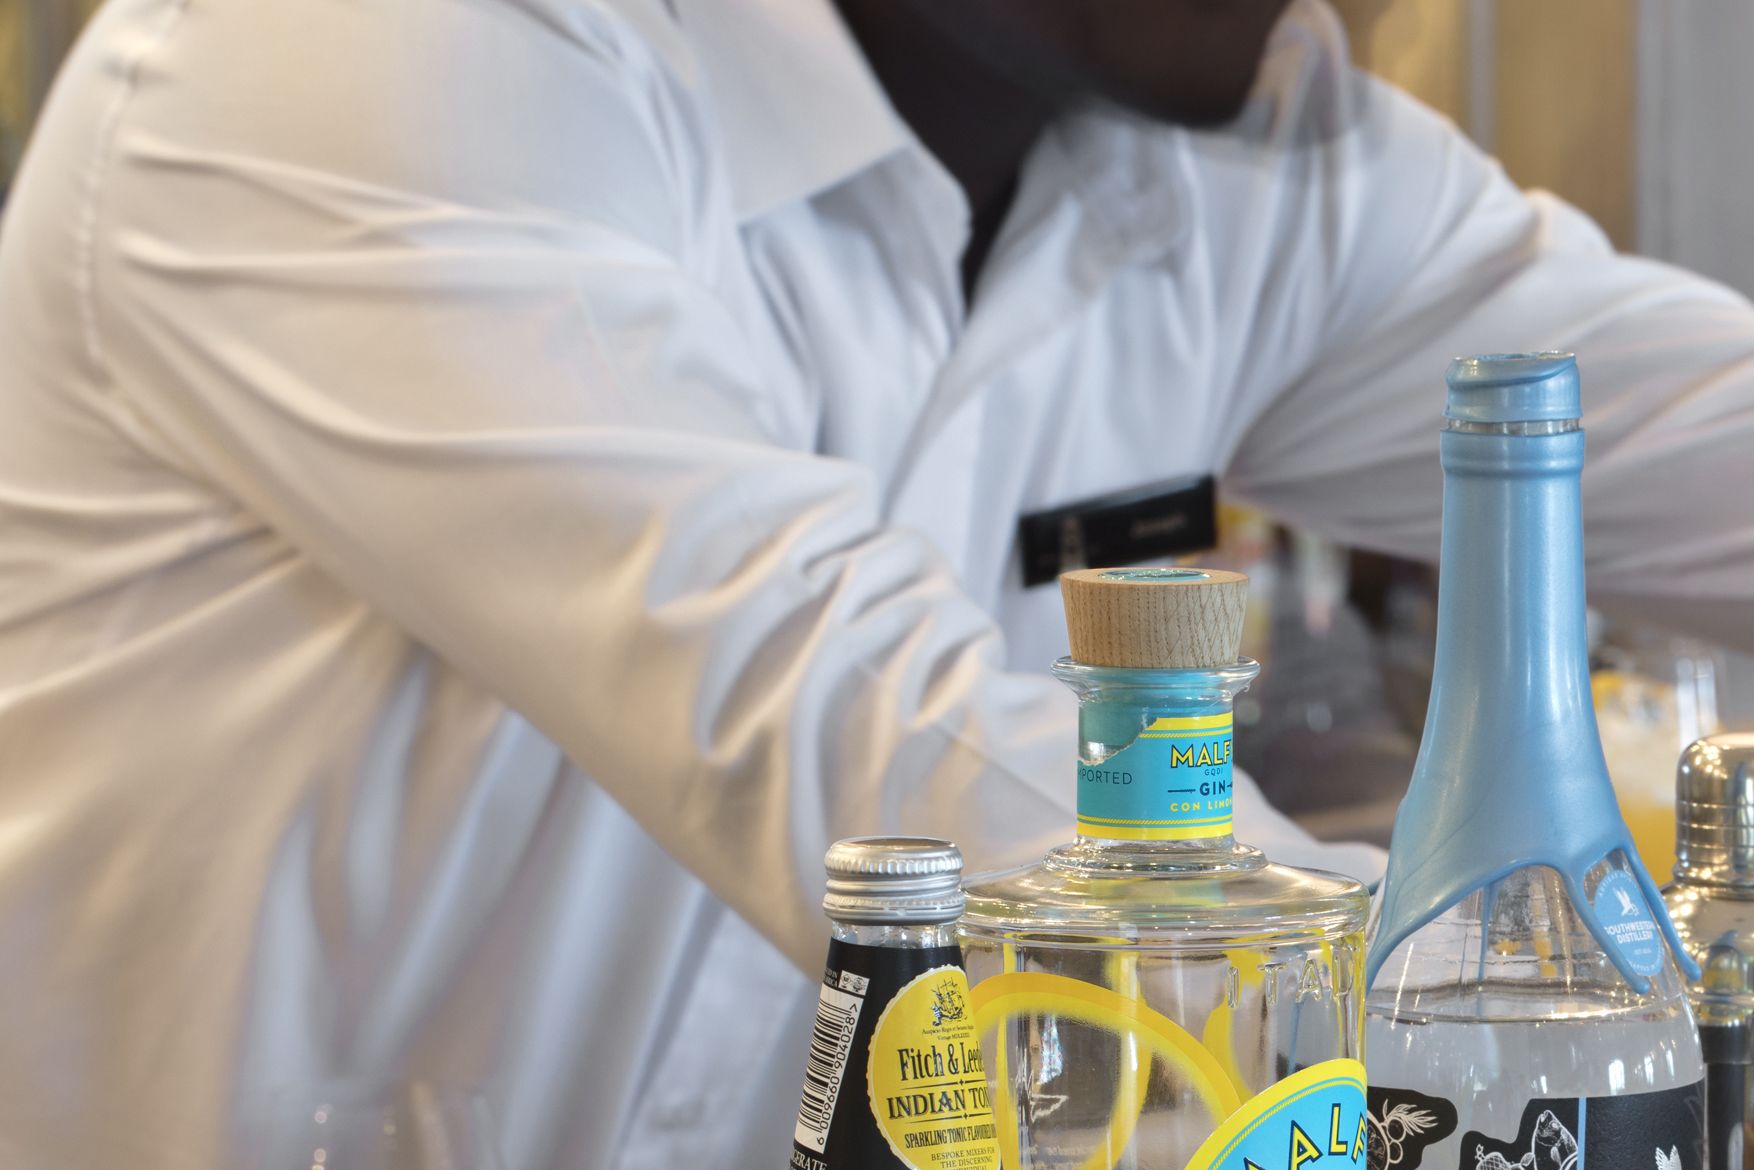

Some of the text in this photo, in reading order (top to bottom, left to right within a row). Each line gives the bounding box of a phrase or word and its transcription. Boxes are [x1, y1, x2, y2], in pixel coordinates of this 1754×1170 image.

[1170, 740, 1232, 768] MALF
[1199, 780, 1226, 797] GIN
[1170, 801, 1200, 812] CON
[819, 1076, 841, 1130] 009660
[834, 1016, 856, 1070] 904028
[897, 1045, 945, 1081] Fitch
[948, 1043, 959, 1075] &
[886, 1088, 965, 1120] INDIAN
[904, 1130, 947, 1148] SPARKLING
[947, 1126, 966, 1144] TONIC
[931, 1150, 964, 1161] BESPOKE
[966, 1147, 986, 1157] MIXERS
[940, 1156, 993, 1170] THE DISCERNING
